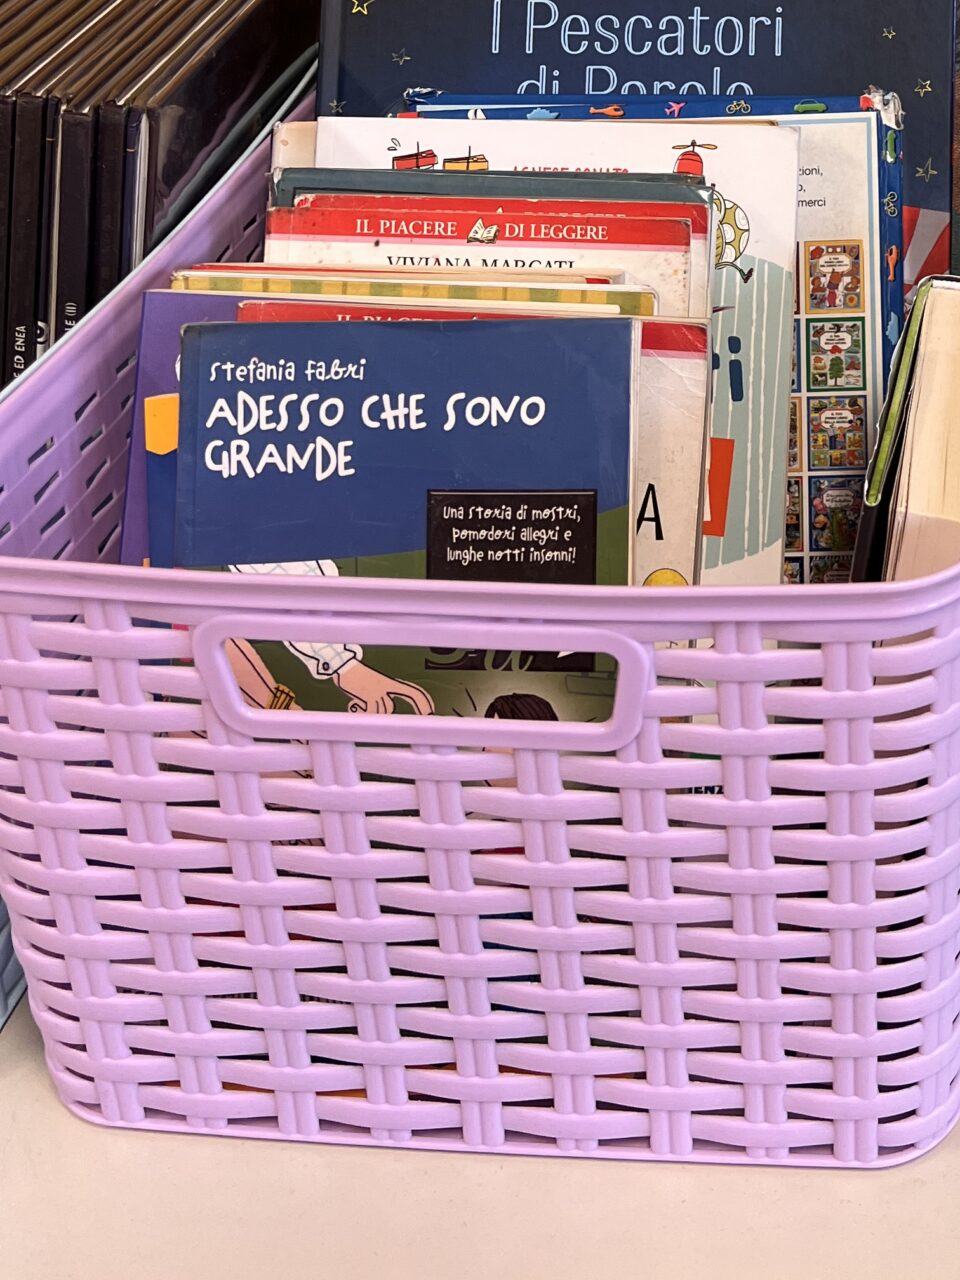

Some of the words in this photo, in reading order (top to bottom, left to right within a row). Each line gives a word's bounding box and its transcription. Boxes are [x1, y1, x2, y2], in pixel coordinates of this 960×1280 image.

[355, 218, 374, 234] IL
[379, 219, 458, 237] PIACERE
[504, 222, 525, 238] DI
[529, 223, 609, 241] LEGGERE
[14, 324, 27, 352] ENEA
[205, 390, 344, 434] ADESSO
[361, 392, 427, 431] CHE
[443, 391, 546, 432] SONO
[204, 436, 356, 481] GRANDE
[468, 503, 512, 520] storia
[516, 504, 528, 520] di
[531, 504, 581, 523] mostri,
[452, 525, 516, 543] pomodori
[520, 525, 560, 546] allegri
[563, 530, 573, 542] e
[447, 546, 484, 566] lunghe
[487, 547, 526, 562] notti
[529, 546, 577, 565] insonni!
